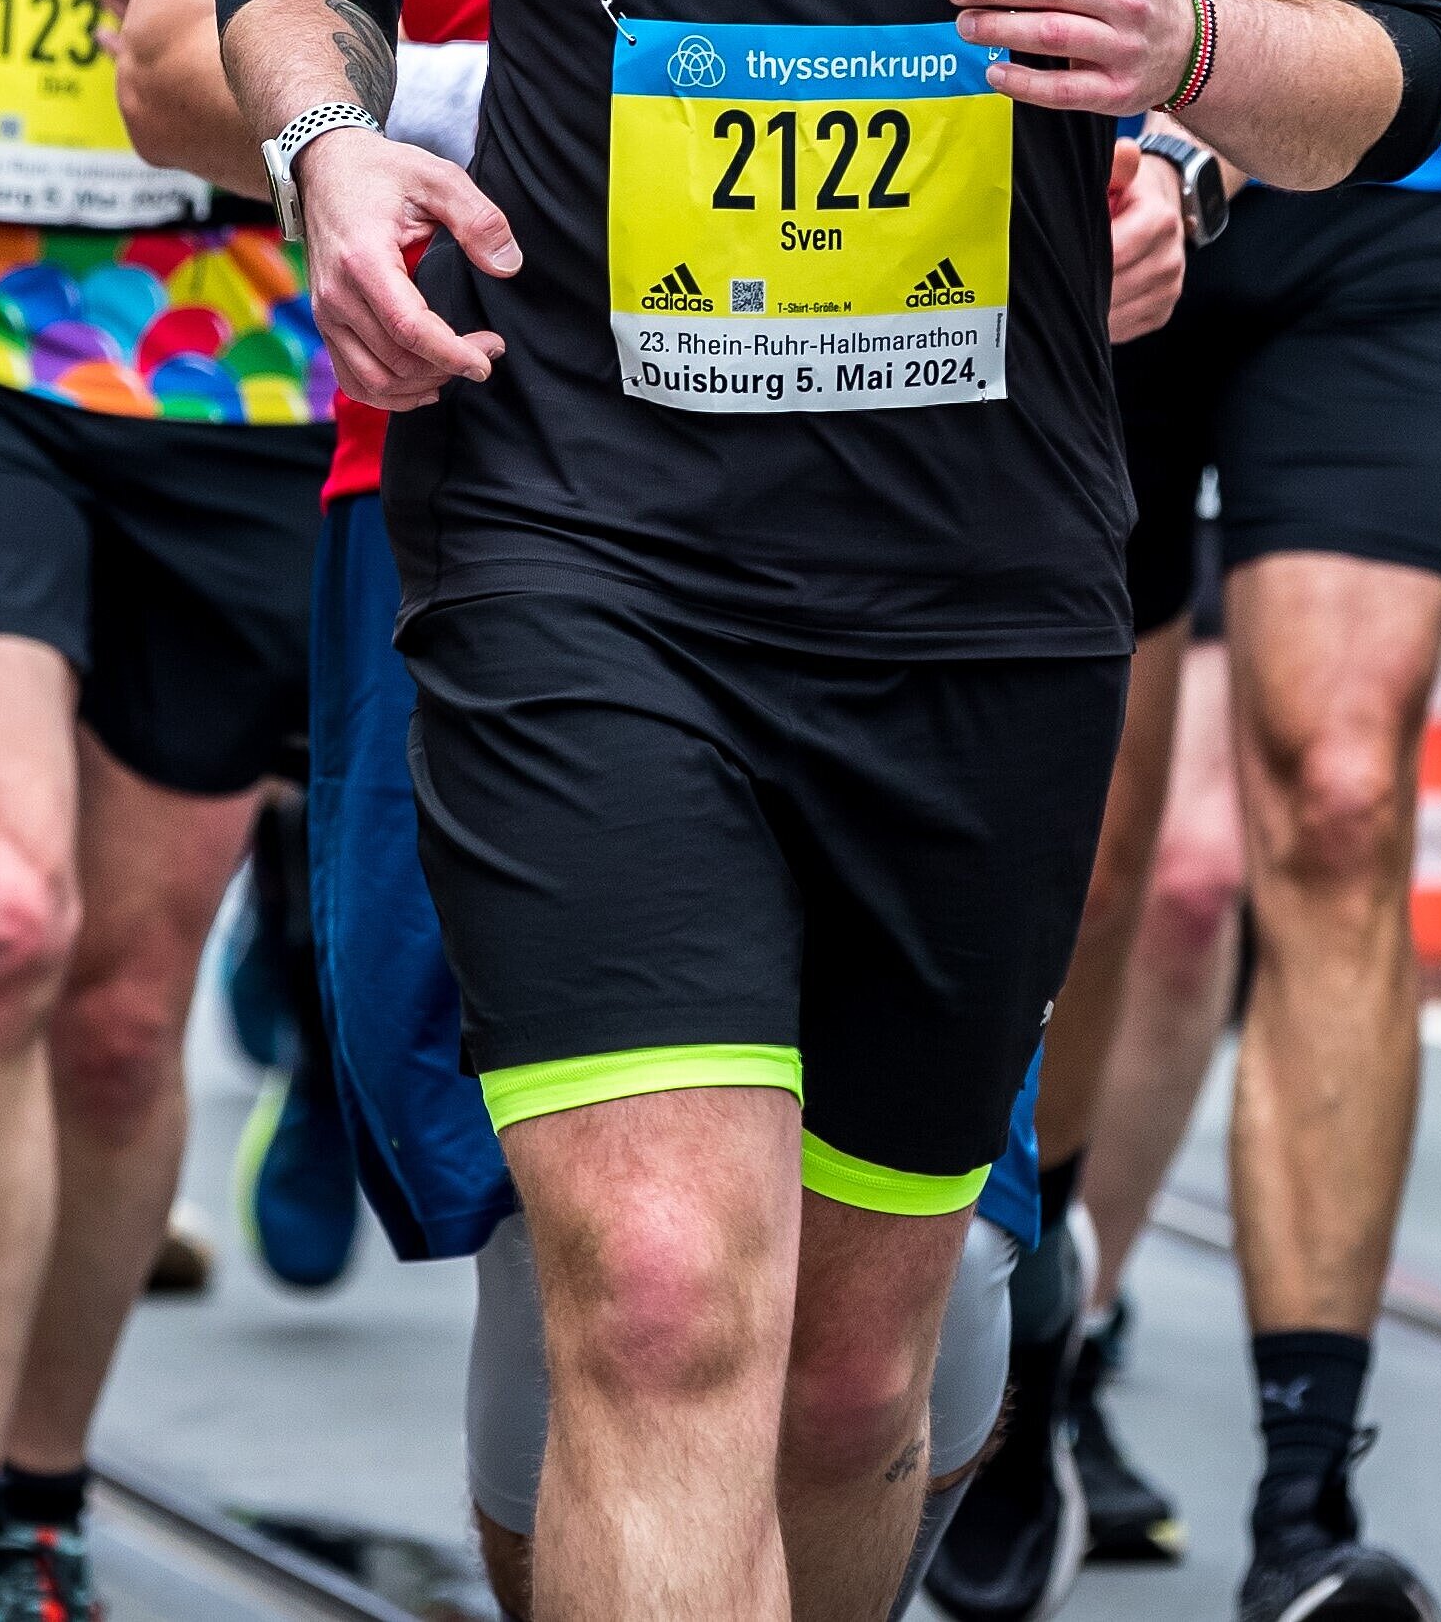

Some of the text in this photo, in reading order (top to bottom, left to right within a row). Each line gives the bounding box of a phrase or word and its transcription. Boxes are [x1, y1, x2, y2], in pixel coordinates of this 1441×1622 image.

[746, 49, 958, 86] thyssenkrupp
[711, 108, 911, 212] 2122
[780, 220, 843, 251] Sven
[641, 292, 714, 313] adidas
[843, 301, 852, 312] M
[905, 287, 976, 309] adidas
[639, 331, 671, 353] 23.
[677, 326, 979, 357] Rhein-Ruhr-Halbmarathon
[641, 360, 785, 399] Duisburg
[796, 366, 824, 394] 5.
[836, 362, 893, 392] Mai
